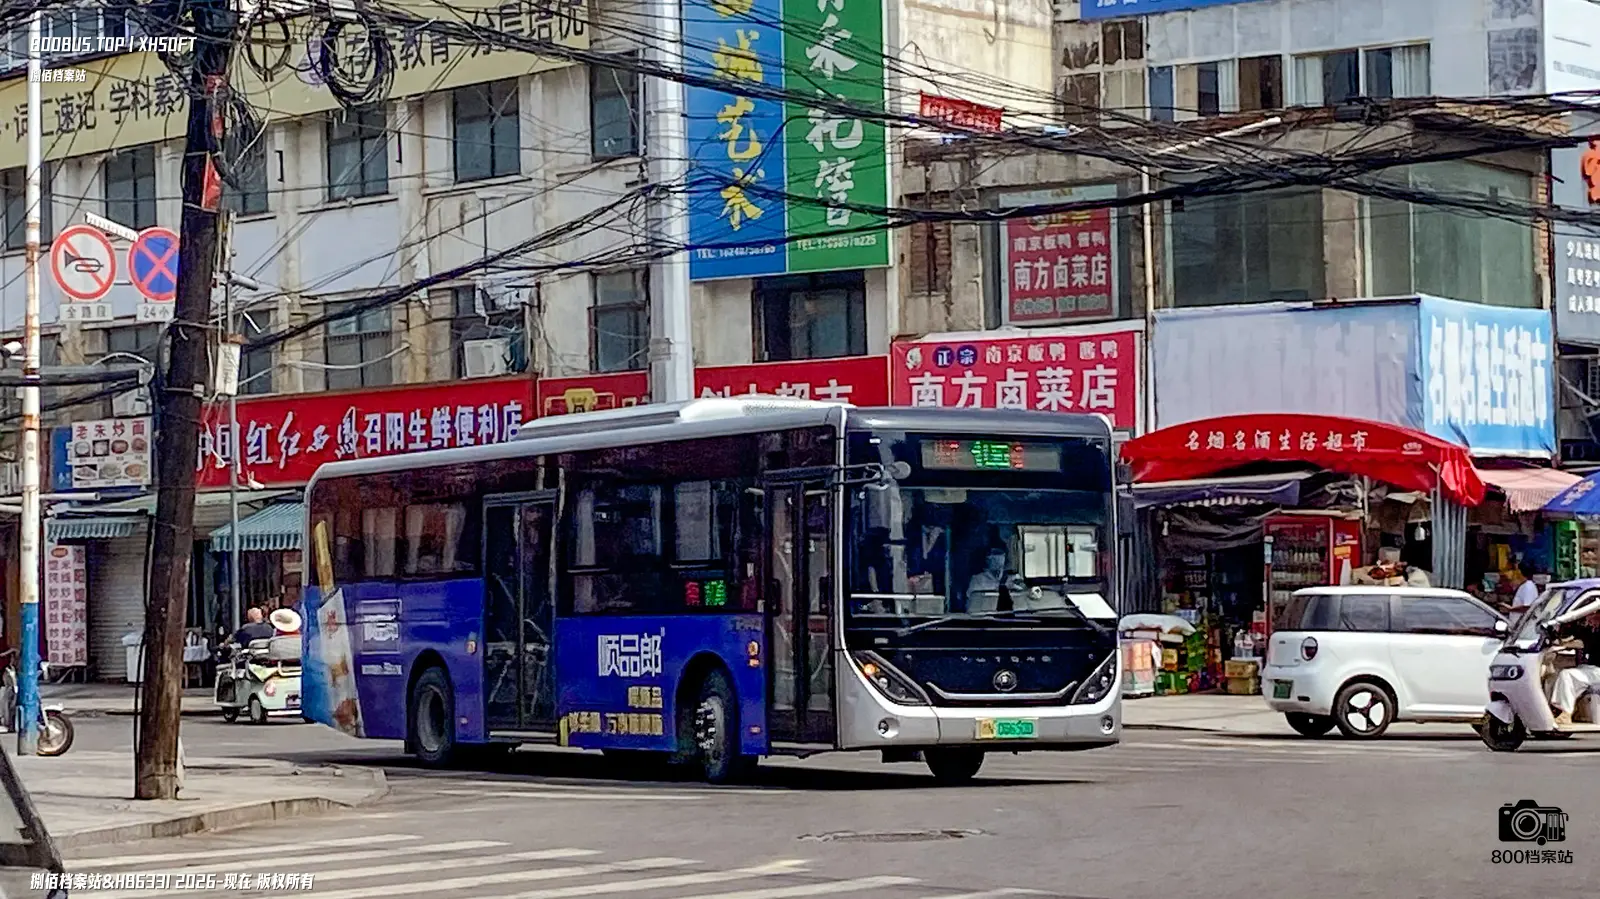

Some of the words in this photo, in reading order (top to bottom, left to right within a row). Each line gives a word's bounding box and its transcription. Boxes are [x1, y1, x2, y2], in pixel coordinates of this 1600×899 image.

[1013, 251, 1108, 292] 南方卤菜店
[936, 347, 975, 367] 正宗
[907, 364, 1119, 411] 南方卤菜店
[1184, 429, 1369, 453] 名烟名酒生活超市
[597, 632, 662, 677] 顺品郎
